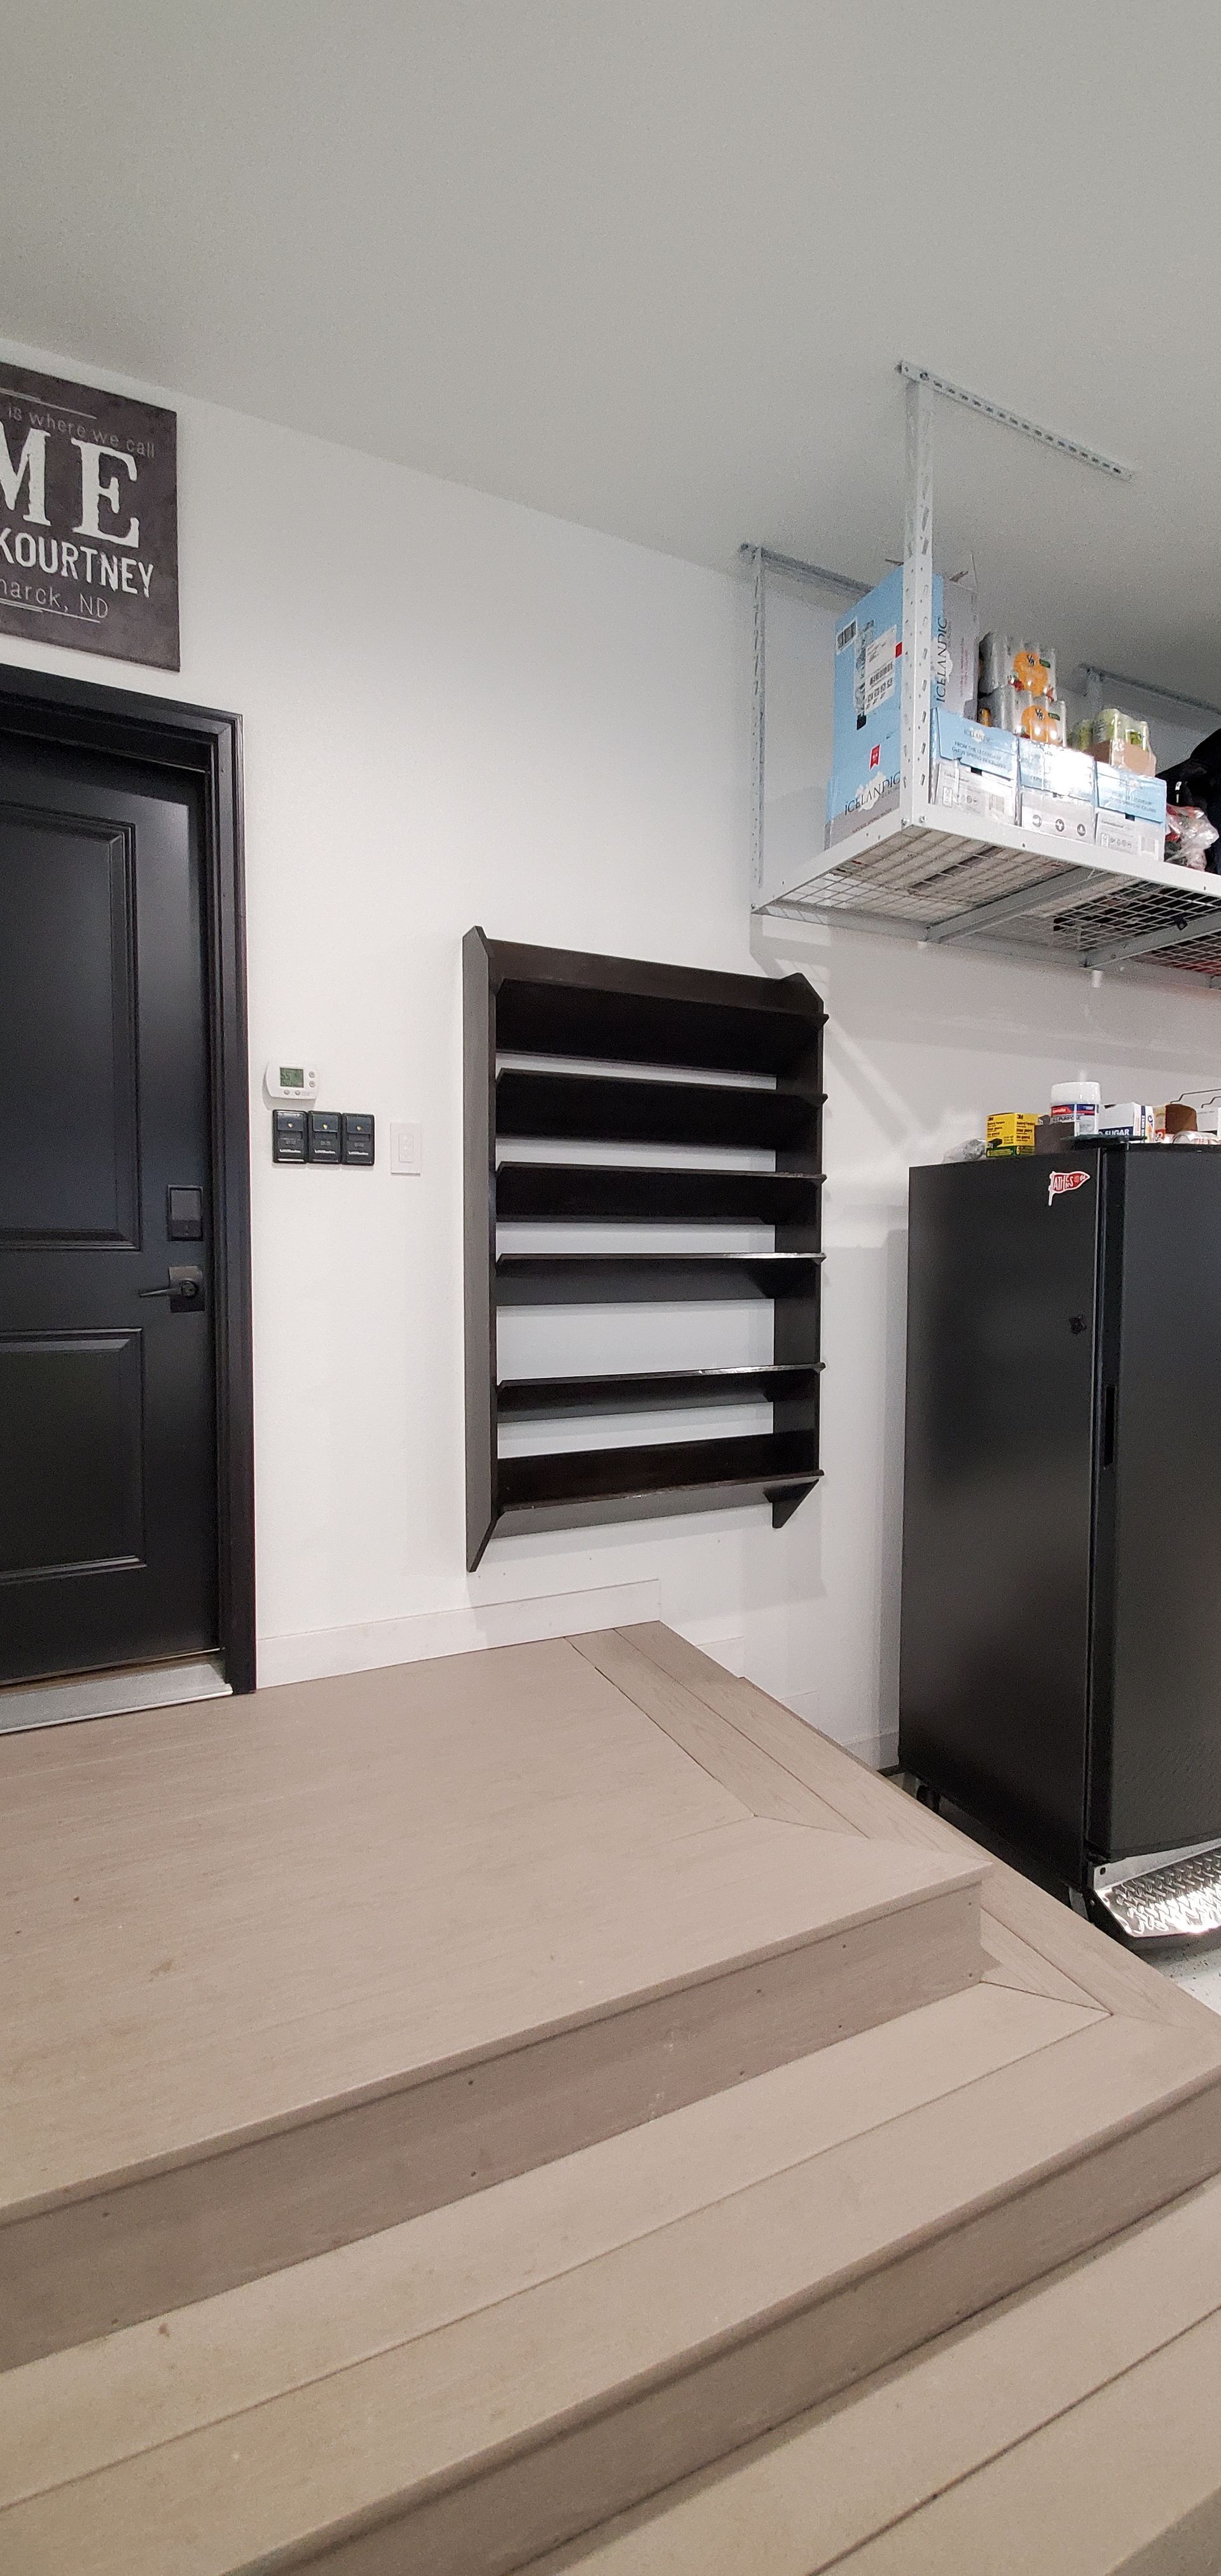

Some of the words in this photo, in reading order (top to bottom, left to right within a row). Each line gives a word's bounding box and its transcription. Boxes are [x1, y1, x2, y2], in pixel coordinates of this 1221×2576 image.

[8, 403, 22, 421] is
[29, 413, 86, 438] where
[93, 429, 120, 447] we
[127, 439, 155, 458] call
[80, 594, 108, 618] ND
[936, 617, 947, 702] ICELANDIC
[1035, 708, 1045, 720] V8
[845, 771, 900, 816] ICELANDIC
